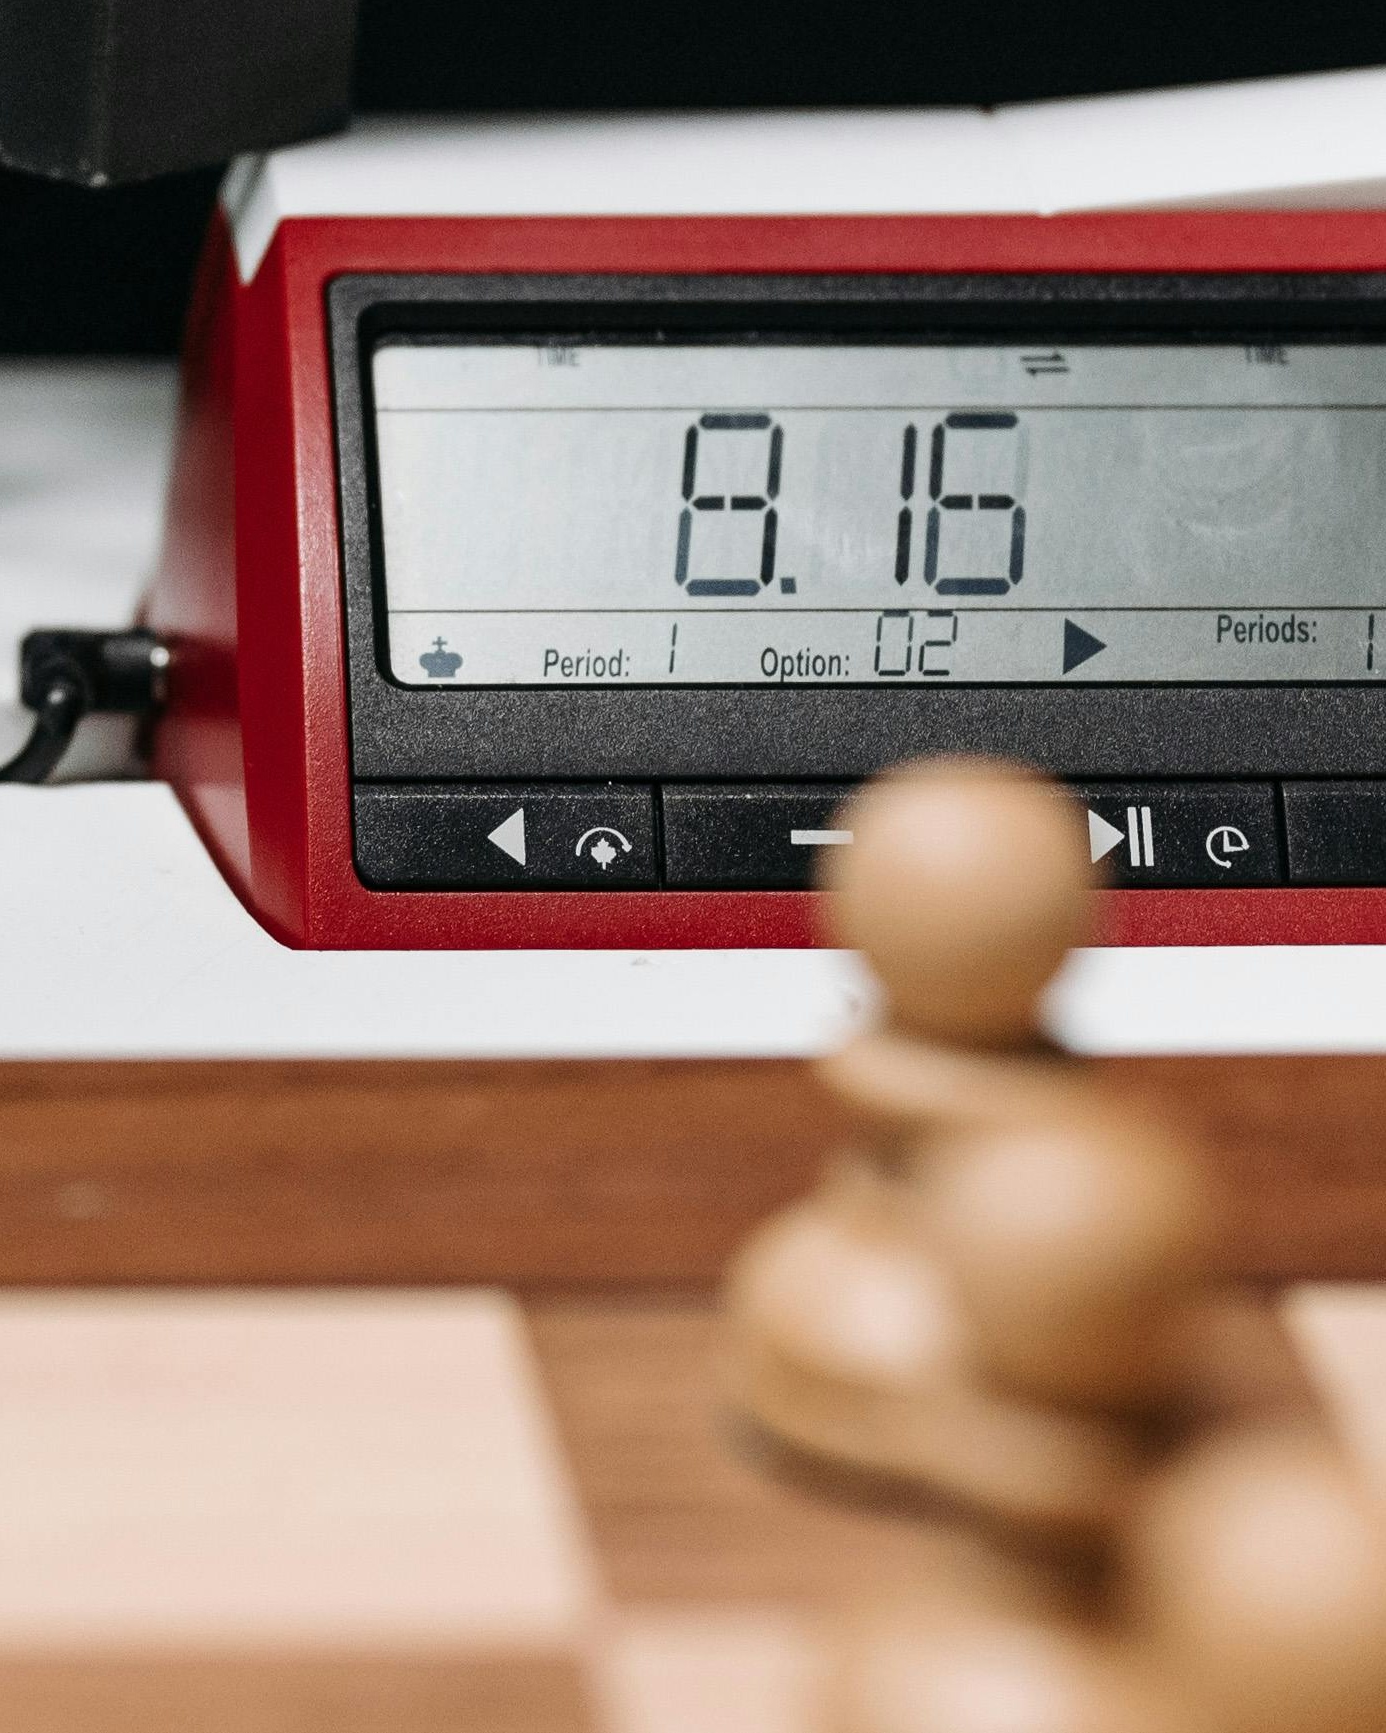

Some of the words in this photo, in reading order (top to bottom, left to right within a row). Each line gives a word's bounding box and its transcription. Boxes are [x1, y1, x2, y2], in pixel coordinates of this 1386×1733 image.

[1216, 613, 1317, 644] Periods:
[760, 647, 850, 682] Option:
[874, 609, 958, 676] 02
[543, 648, 630, 678] Period:
